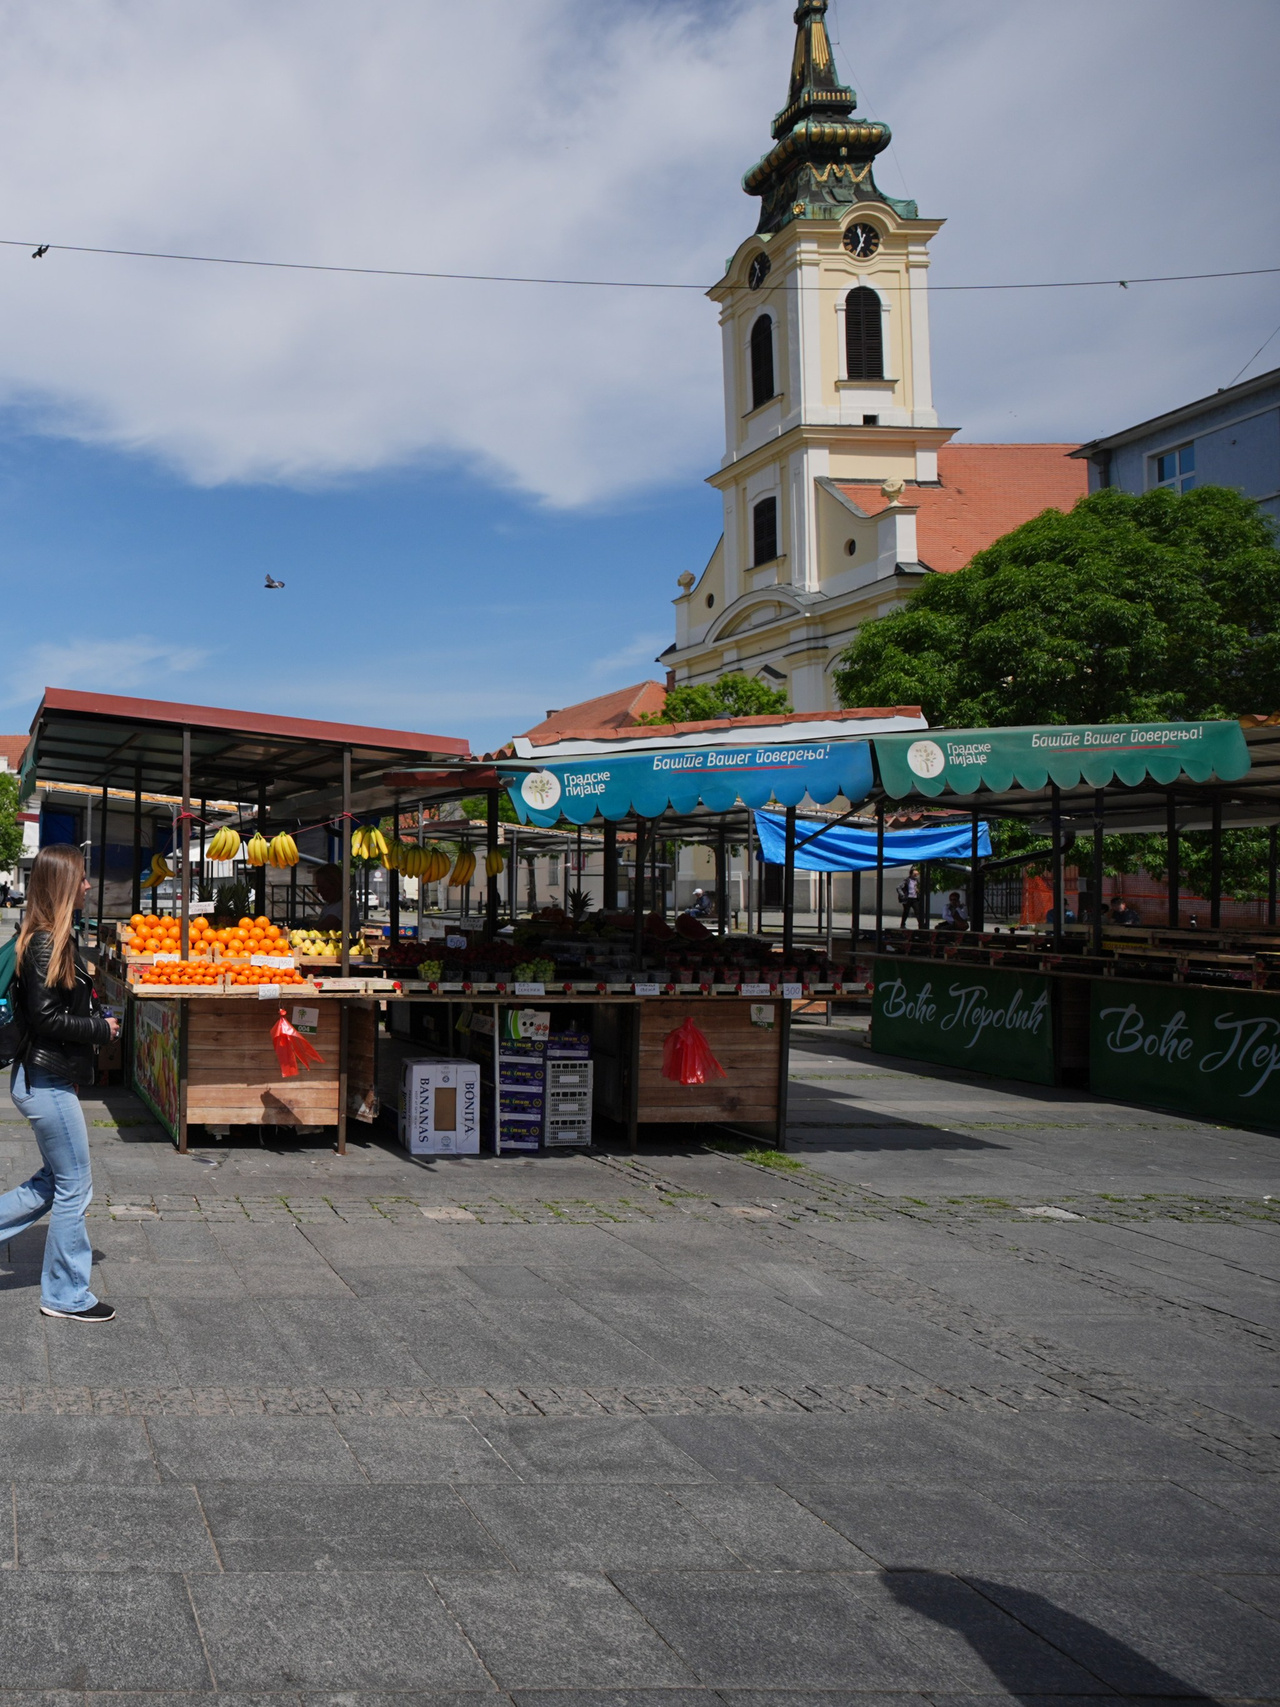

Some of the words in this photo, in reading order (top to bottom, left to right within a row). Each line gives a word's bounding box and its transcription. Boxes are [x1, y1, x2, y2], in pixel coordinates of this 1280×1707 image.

[1031, 732, 1081, 748] Баште
[1083, 730, 1127, 745] Вашег
[1130, 726, 1204, 746] поверења!
[652, 754, 704, 771] Баште
[706, 751, 750, 767] Вашег
[754, 745, 831, 766] поверења!
[946, 742, 992, 757] Градске
[949, 752, 988, 767] пијаце
[563, 771, 611, 788] Градске
[564, 782, 606, 798] пијаце
[785, 986, 800, 995] 300
[878, 977, 937, 1024] Воће
[940, 981, 1050, 1049] Перовић
[1099, 1003, 1194, 1063] Воће
[418, 1078, 430, 1143] BANANAS
[464, 1082, 475, 1133] BONITA
